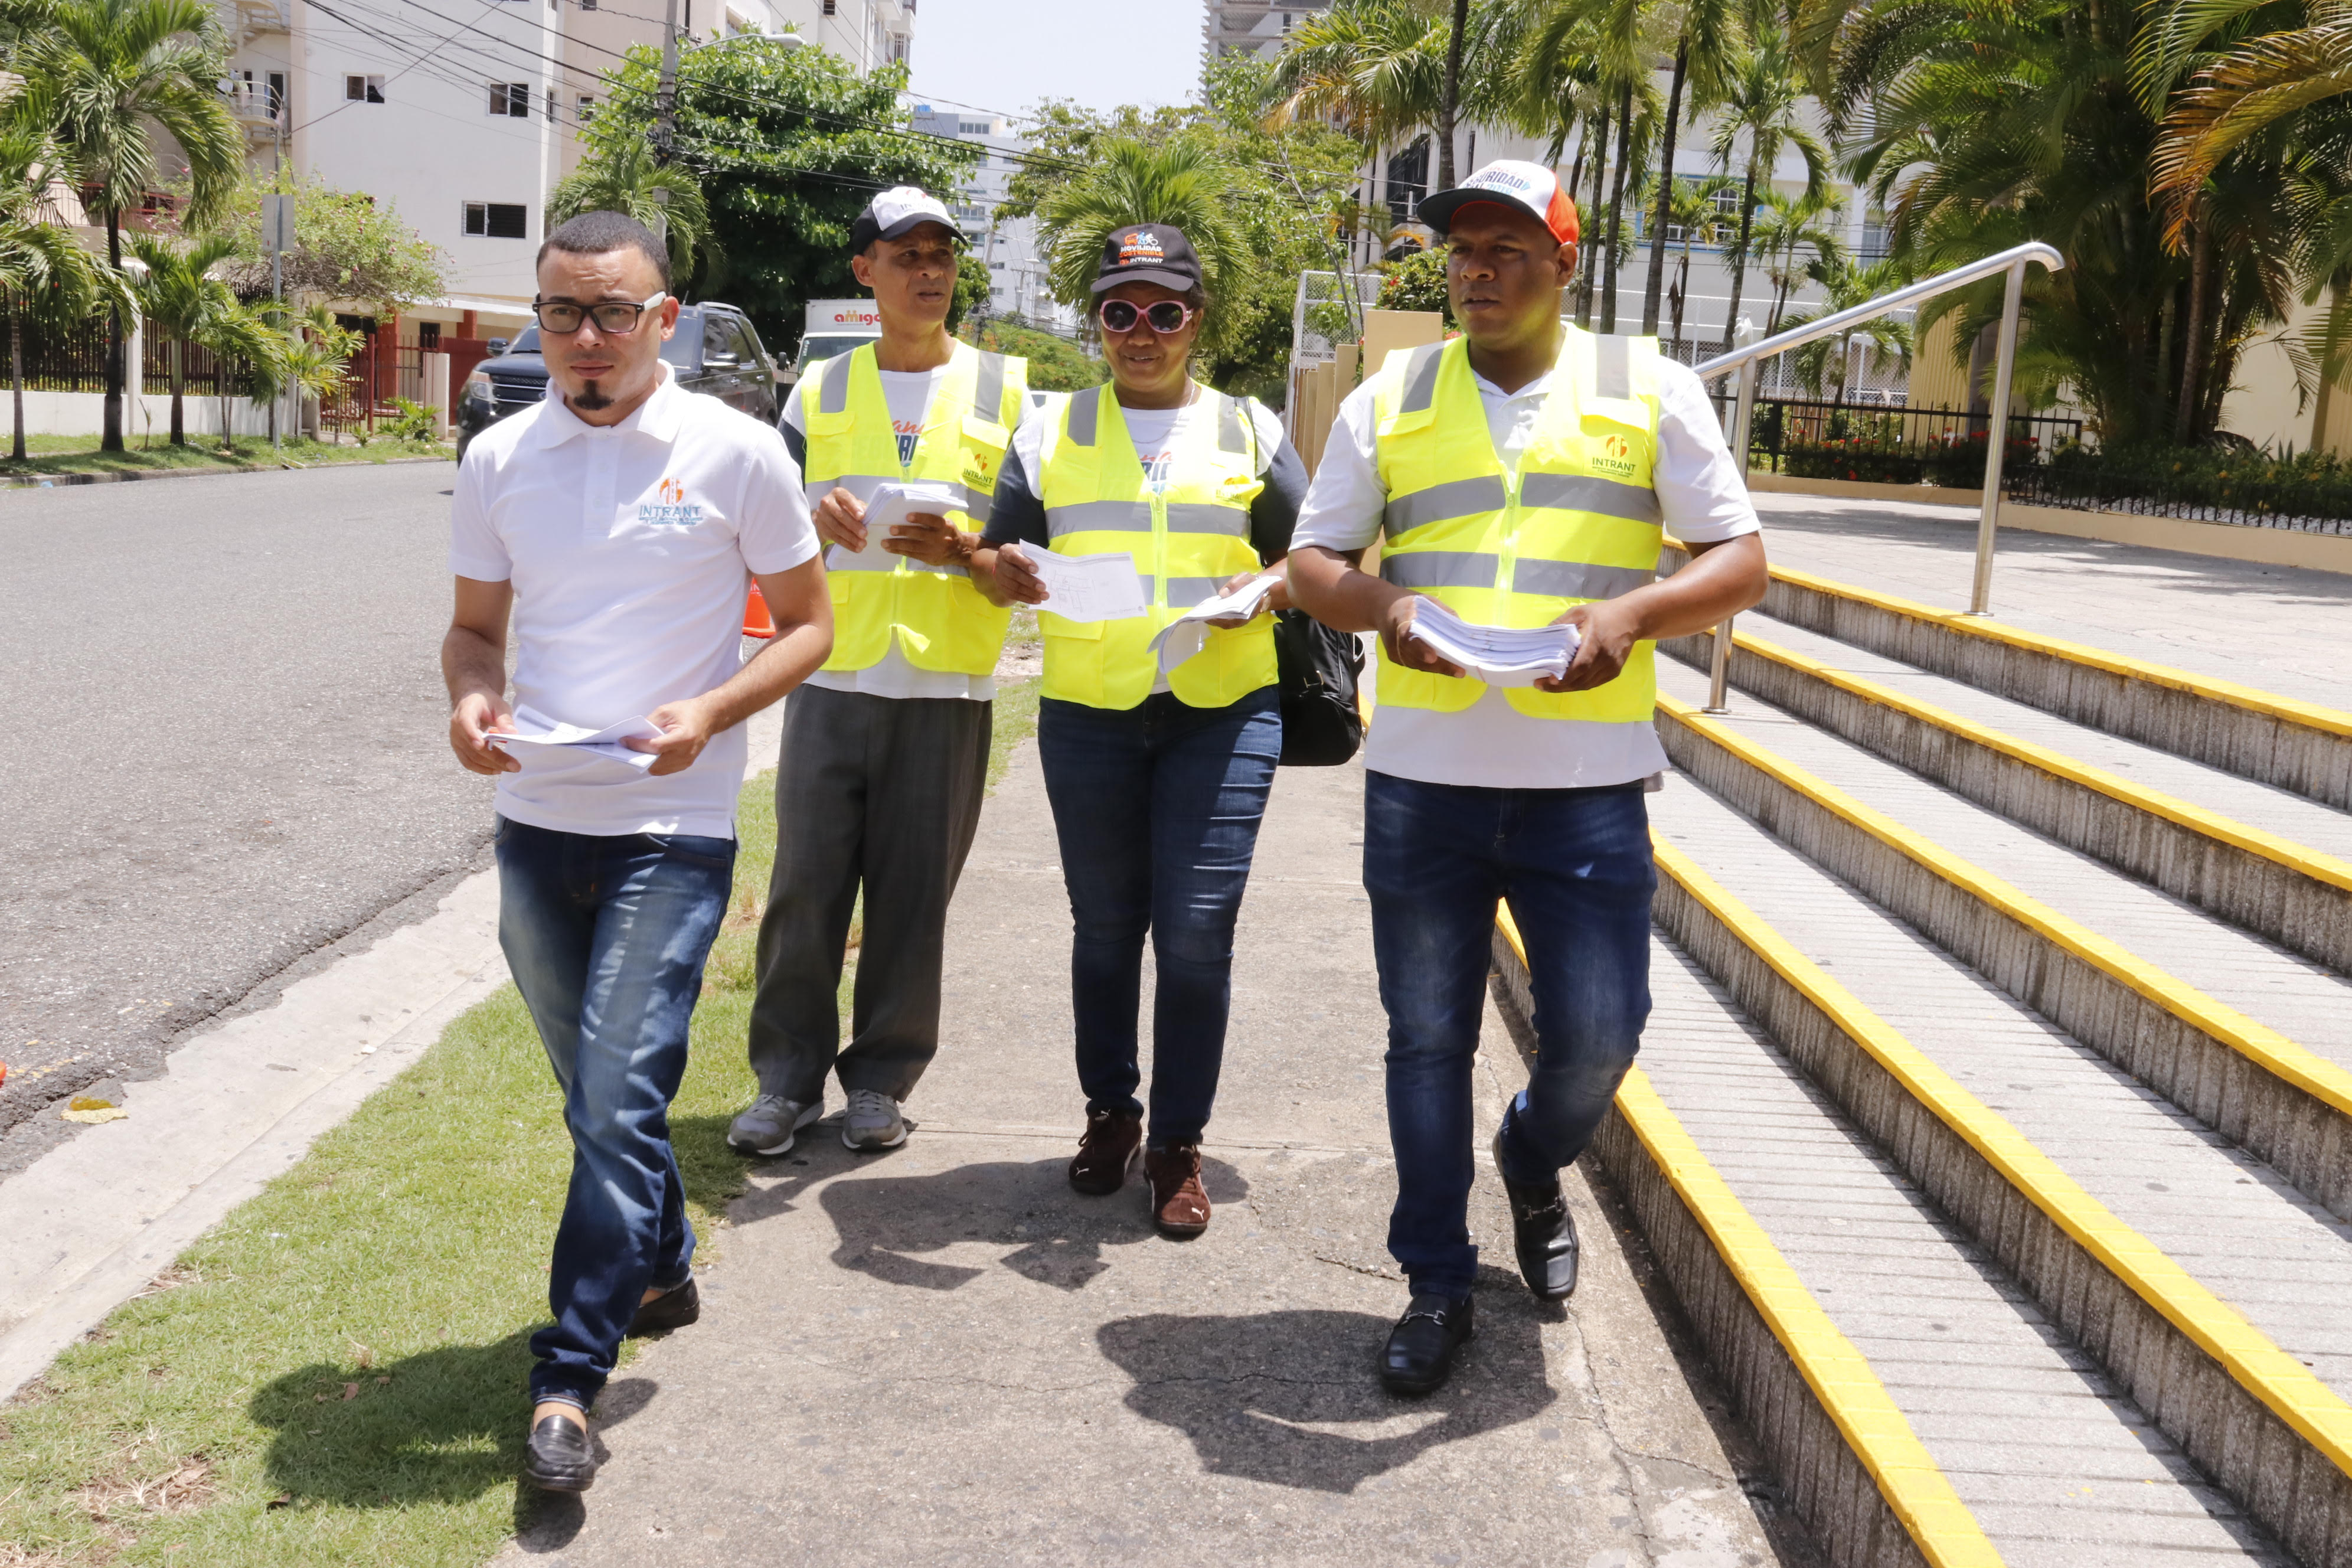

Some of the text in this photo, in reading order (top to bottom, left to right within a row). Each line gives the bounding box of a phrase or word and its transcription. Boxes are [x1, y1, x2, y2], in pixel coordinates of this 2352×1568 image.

[1592, 457, 1636, 472] INTRANT
[963, 468, 993, 484] INTRANT
[639, 505, 701, 517] INTRANT
